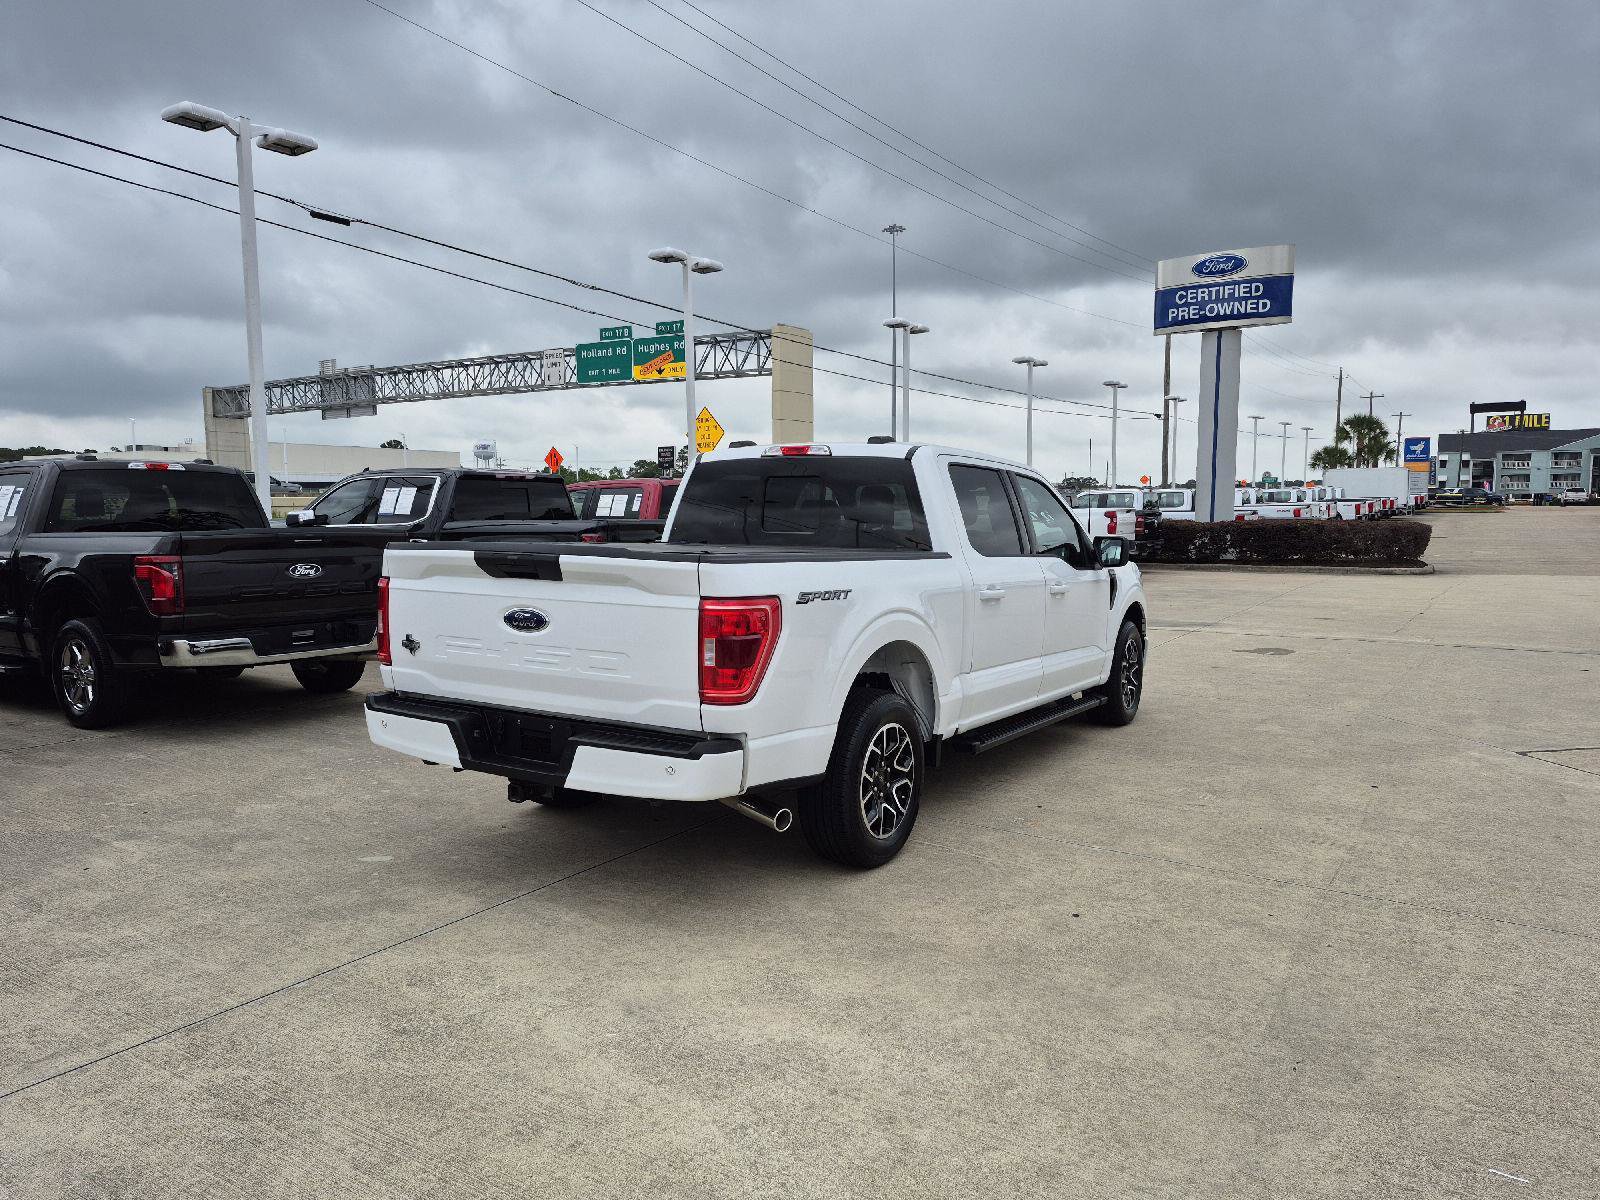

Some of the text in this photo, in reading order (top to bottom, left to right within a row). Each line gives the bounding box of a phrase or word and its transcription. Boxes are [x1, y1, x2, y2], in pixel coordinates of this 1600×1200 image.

[1202, 257, 1235, 273] Ford
[1175, 282, 1264, 305] CERTIFIED
[1168, 298, 1271, 322] PRE-OWNED
[581, 346, 627, 359] Holland Rd
[638, 340, 685, 354] Hughes Rd
[544, 352, 563, 360] SPEED
[547, 361, 561, 369] LIMIT
[1515, 414, 1550, 428] MILE
[294, 565, 316, 575] Ford
[796, 588, 852, 605] SPORT
[512, 612, 537, 627] Ford
